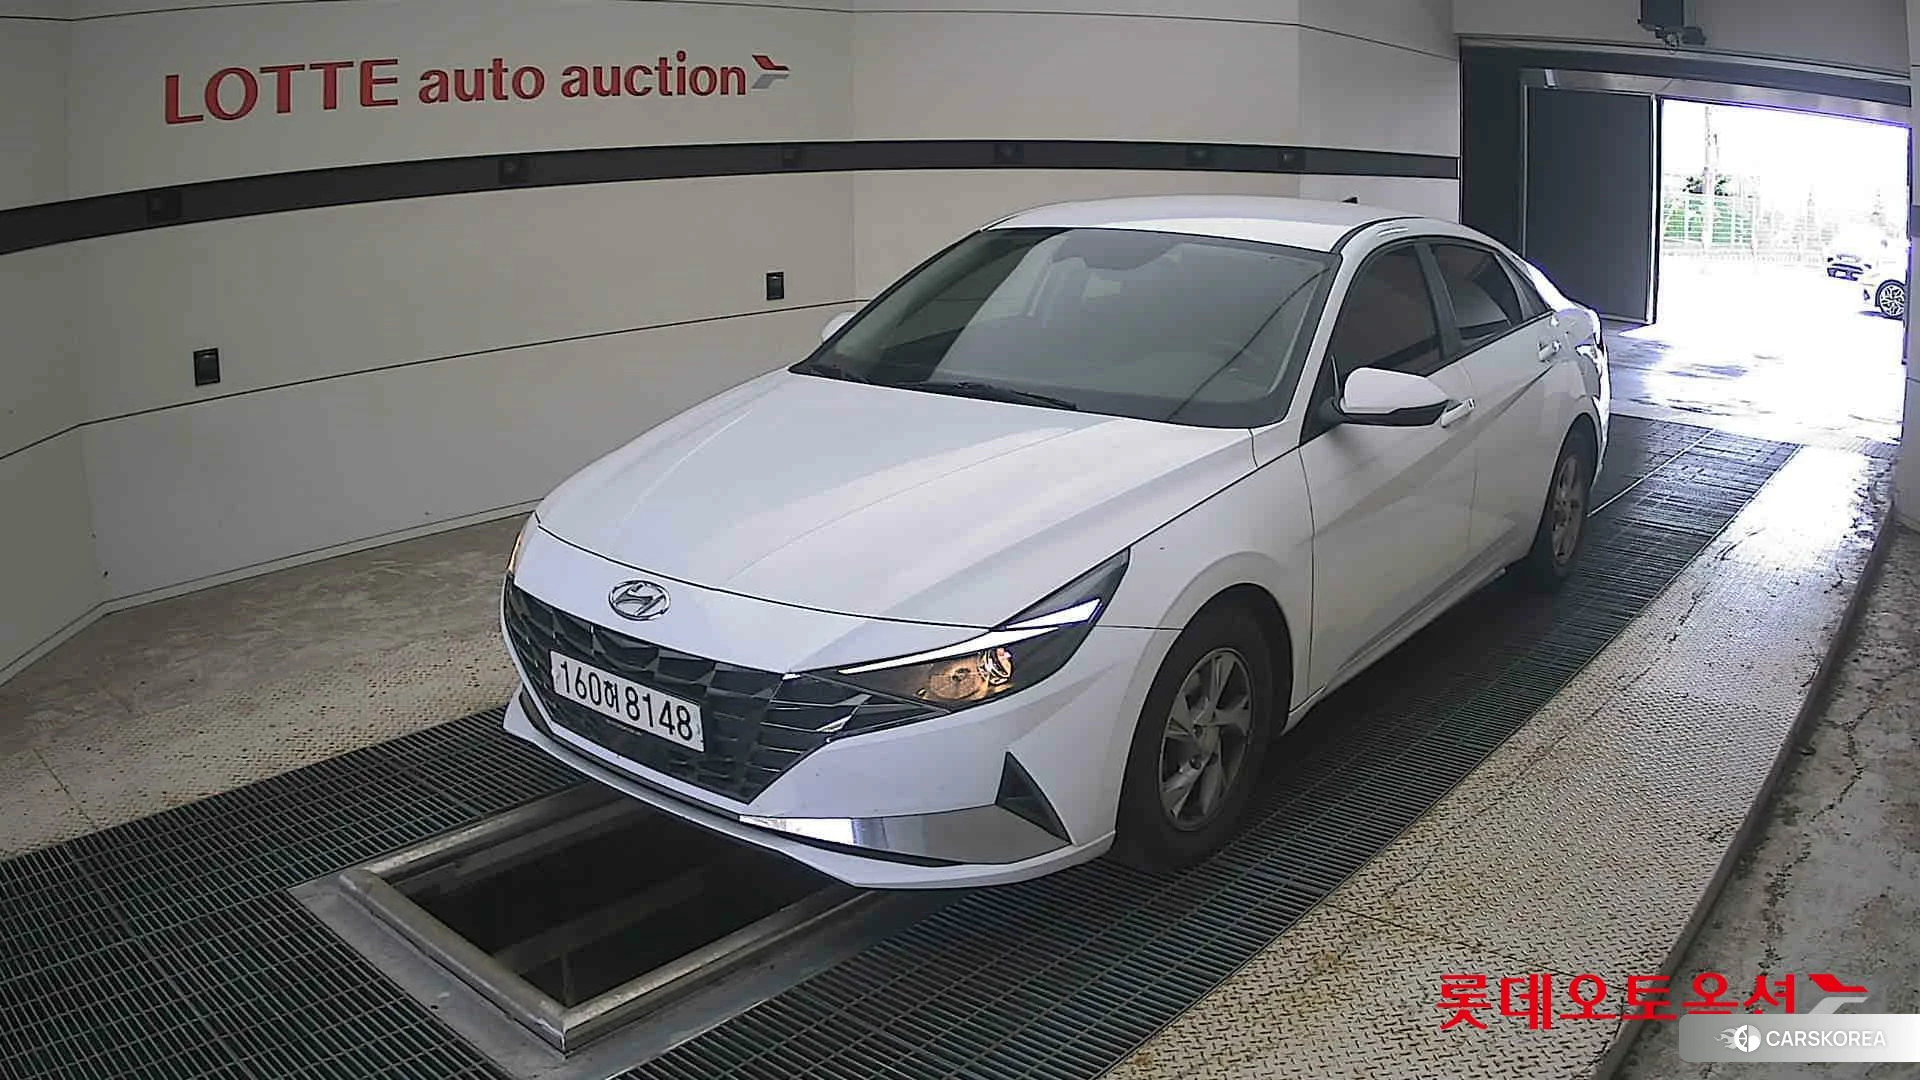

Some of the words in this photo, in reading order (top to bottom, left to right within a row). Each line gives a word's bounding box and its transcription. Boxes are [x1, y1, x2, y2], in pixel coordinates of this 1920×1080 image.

[165, 58, 399, 125] LOTTE
[418, 57, 545, 103] auto
[560, 50, 747, 98] auction
